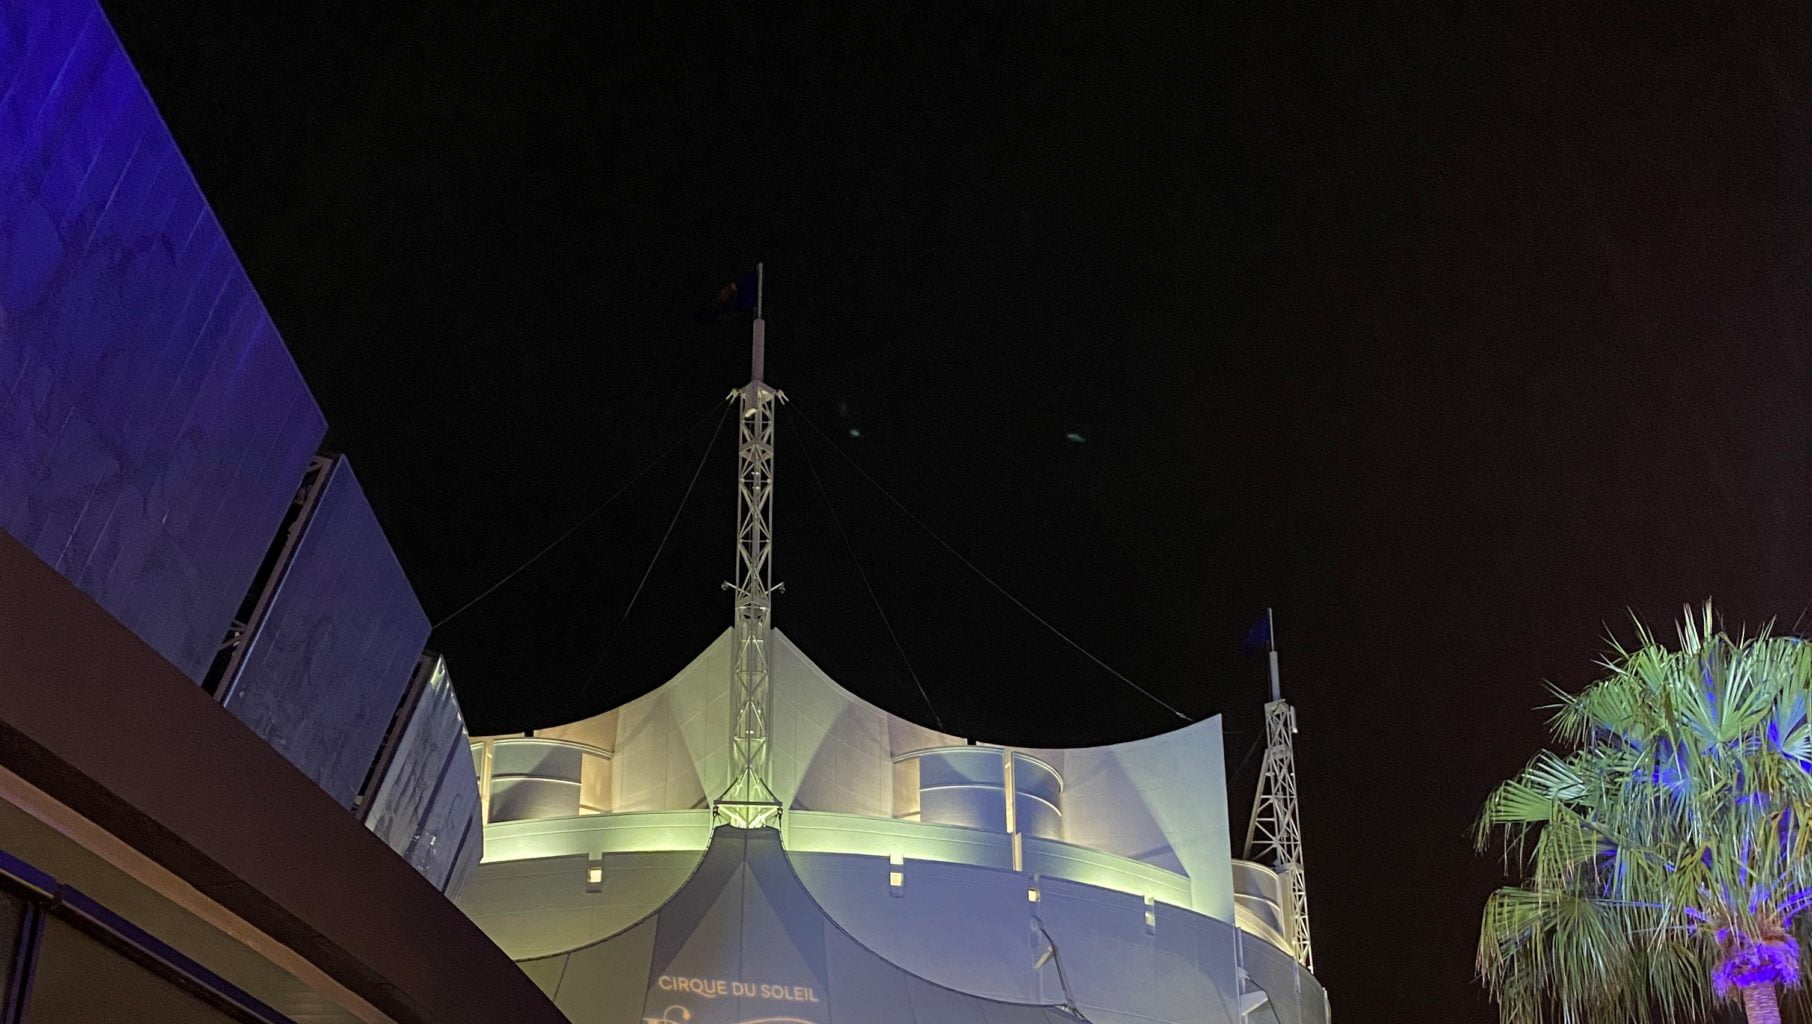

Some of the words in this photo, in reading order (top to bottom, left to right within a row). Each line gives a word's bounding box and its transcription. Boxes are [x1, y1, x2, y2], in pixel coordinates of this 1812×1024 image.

[658, 975, 728, 998] CIRQUE
[731, 981, 757, 998] DU
[760, 984, 819, 1003] SOLEIL
